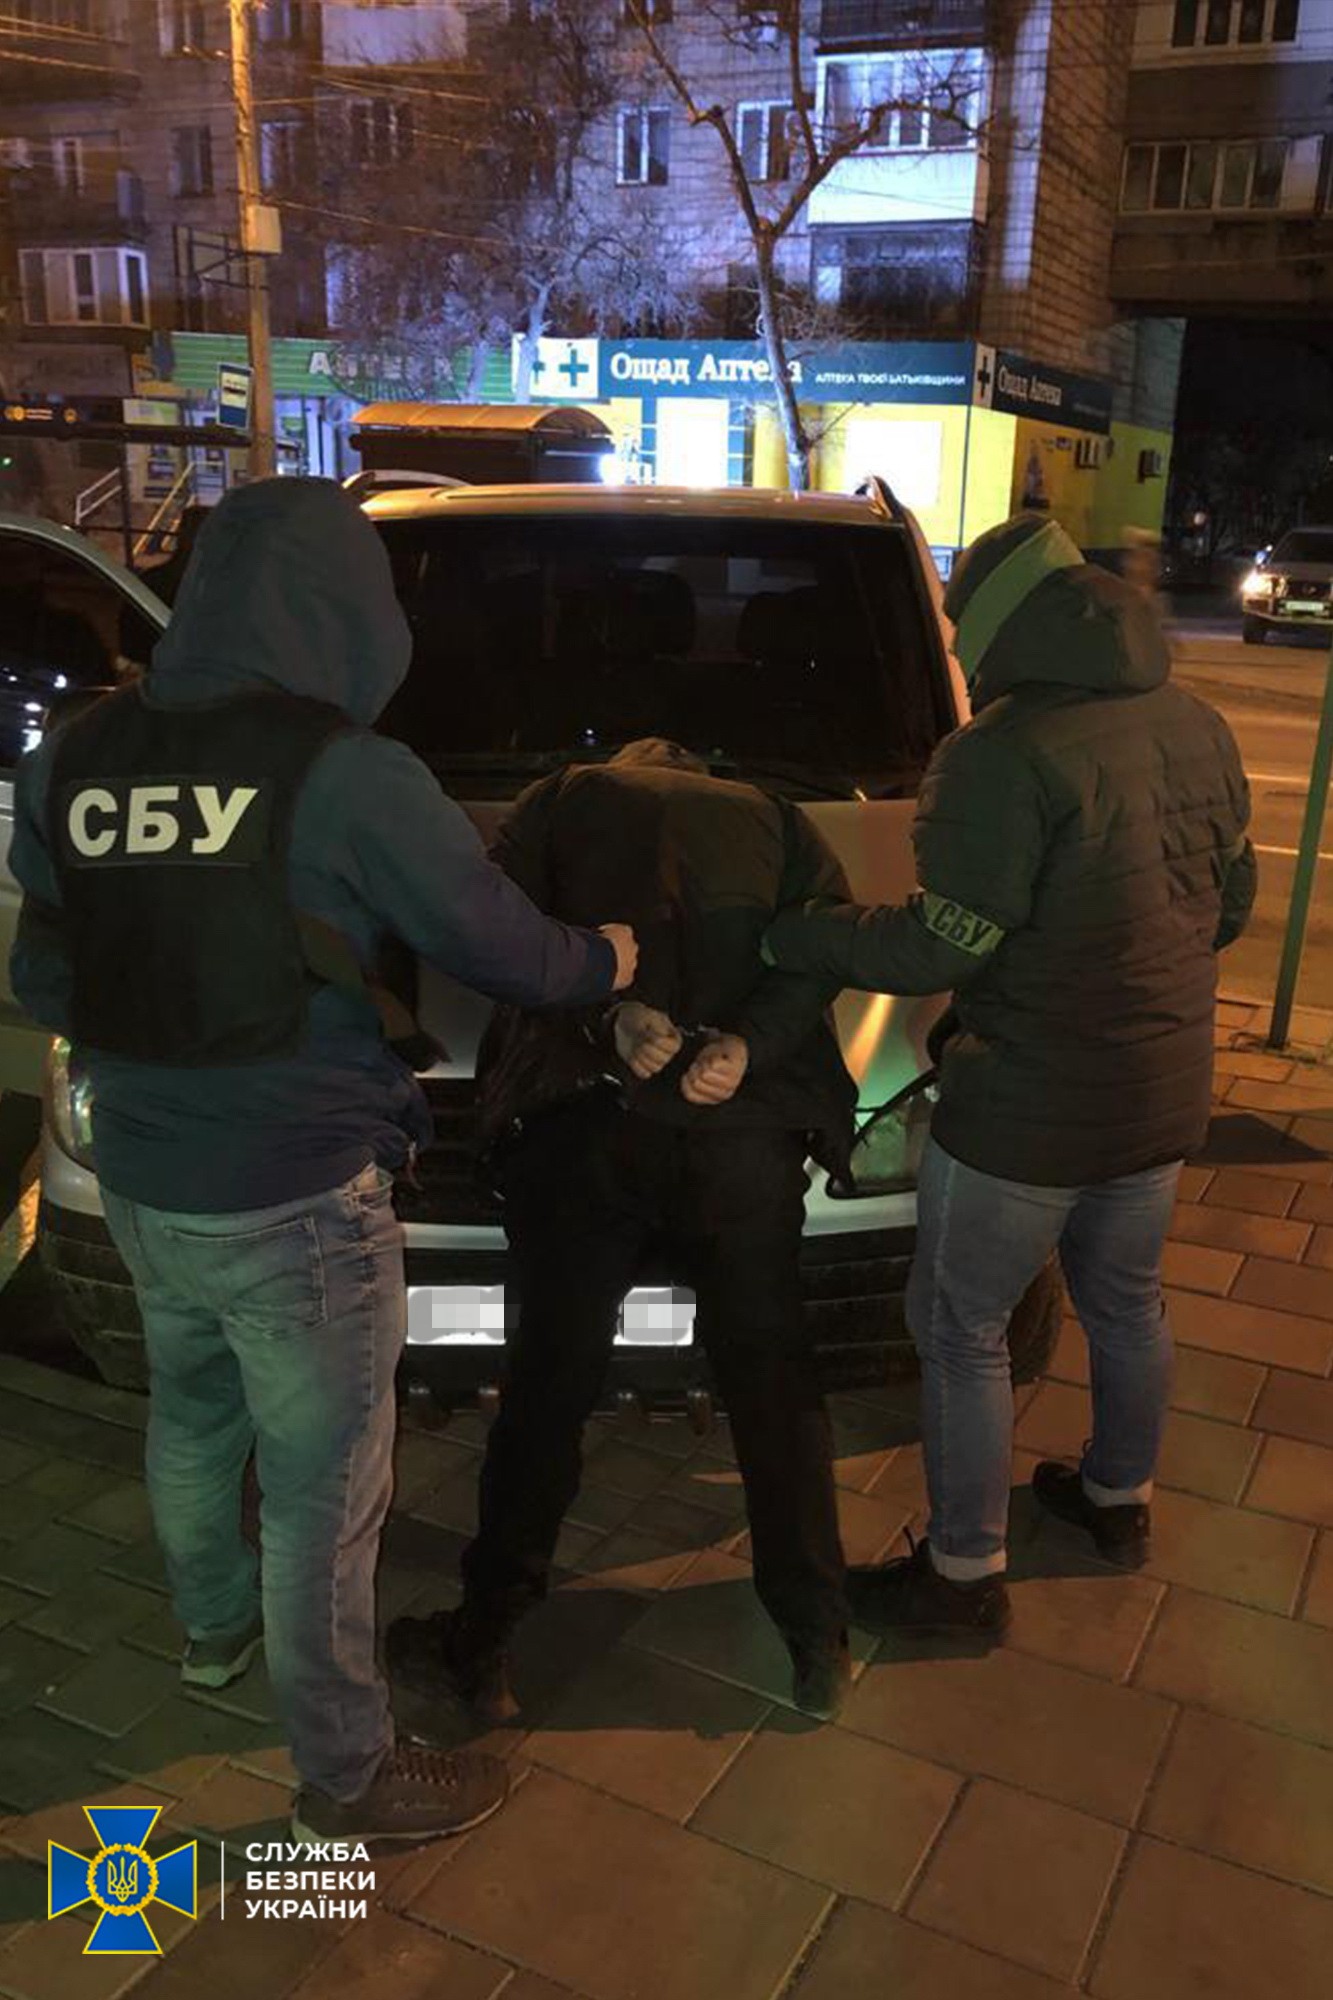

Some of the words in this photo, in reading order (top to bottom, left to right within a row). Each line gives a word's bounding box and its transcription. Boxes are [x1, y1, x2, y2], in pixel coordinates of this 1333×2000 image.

[610, 352, 690, 385] Ощад
[697, 353, 803, 383] Аптеа
[815, 372, 855, 384] АПТЕКА
[68, 786, 259, 857] СБУ
[931, 901, 993, 948] СБУ
